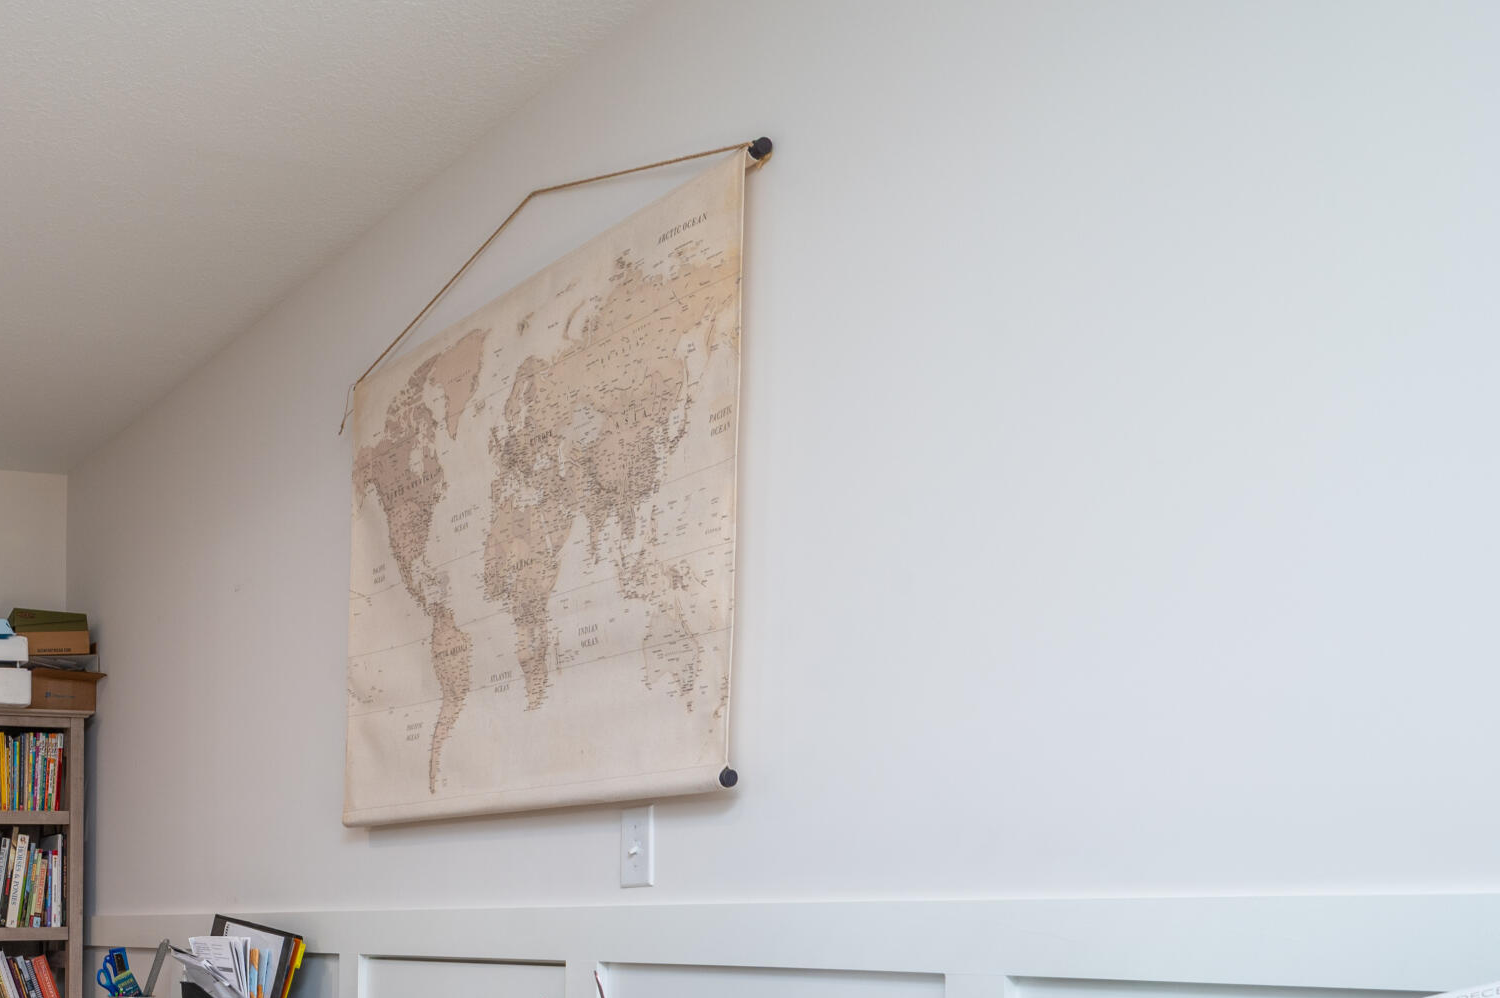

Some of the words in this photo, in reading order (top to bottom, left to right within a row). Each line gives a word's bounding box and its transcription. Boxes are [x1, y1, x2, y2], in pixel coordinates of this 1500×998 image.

[658, 225, 681, 244] ARCTIC
[682, 212, 707, 231] OCEAN
[709, 405, 732, 423] PACIFIC
[710, 422, 730, 436] OCEAN
[451, 508, 473, 523] ATLANTIC
[454, 521, 469, 533] OCEAN
[578, 624, 598, 636] INDIAN
[580, 637, 599, 648] OCEAN
[491, 671, 512, 683] ATLANTIC
[15, 845, 24, 869] HORSES
[11, 880, 19, 905] PONIES
